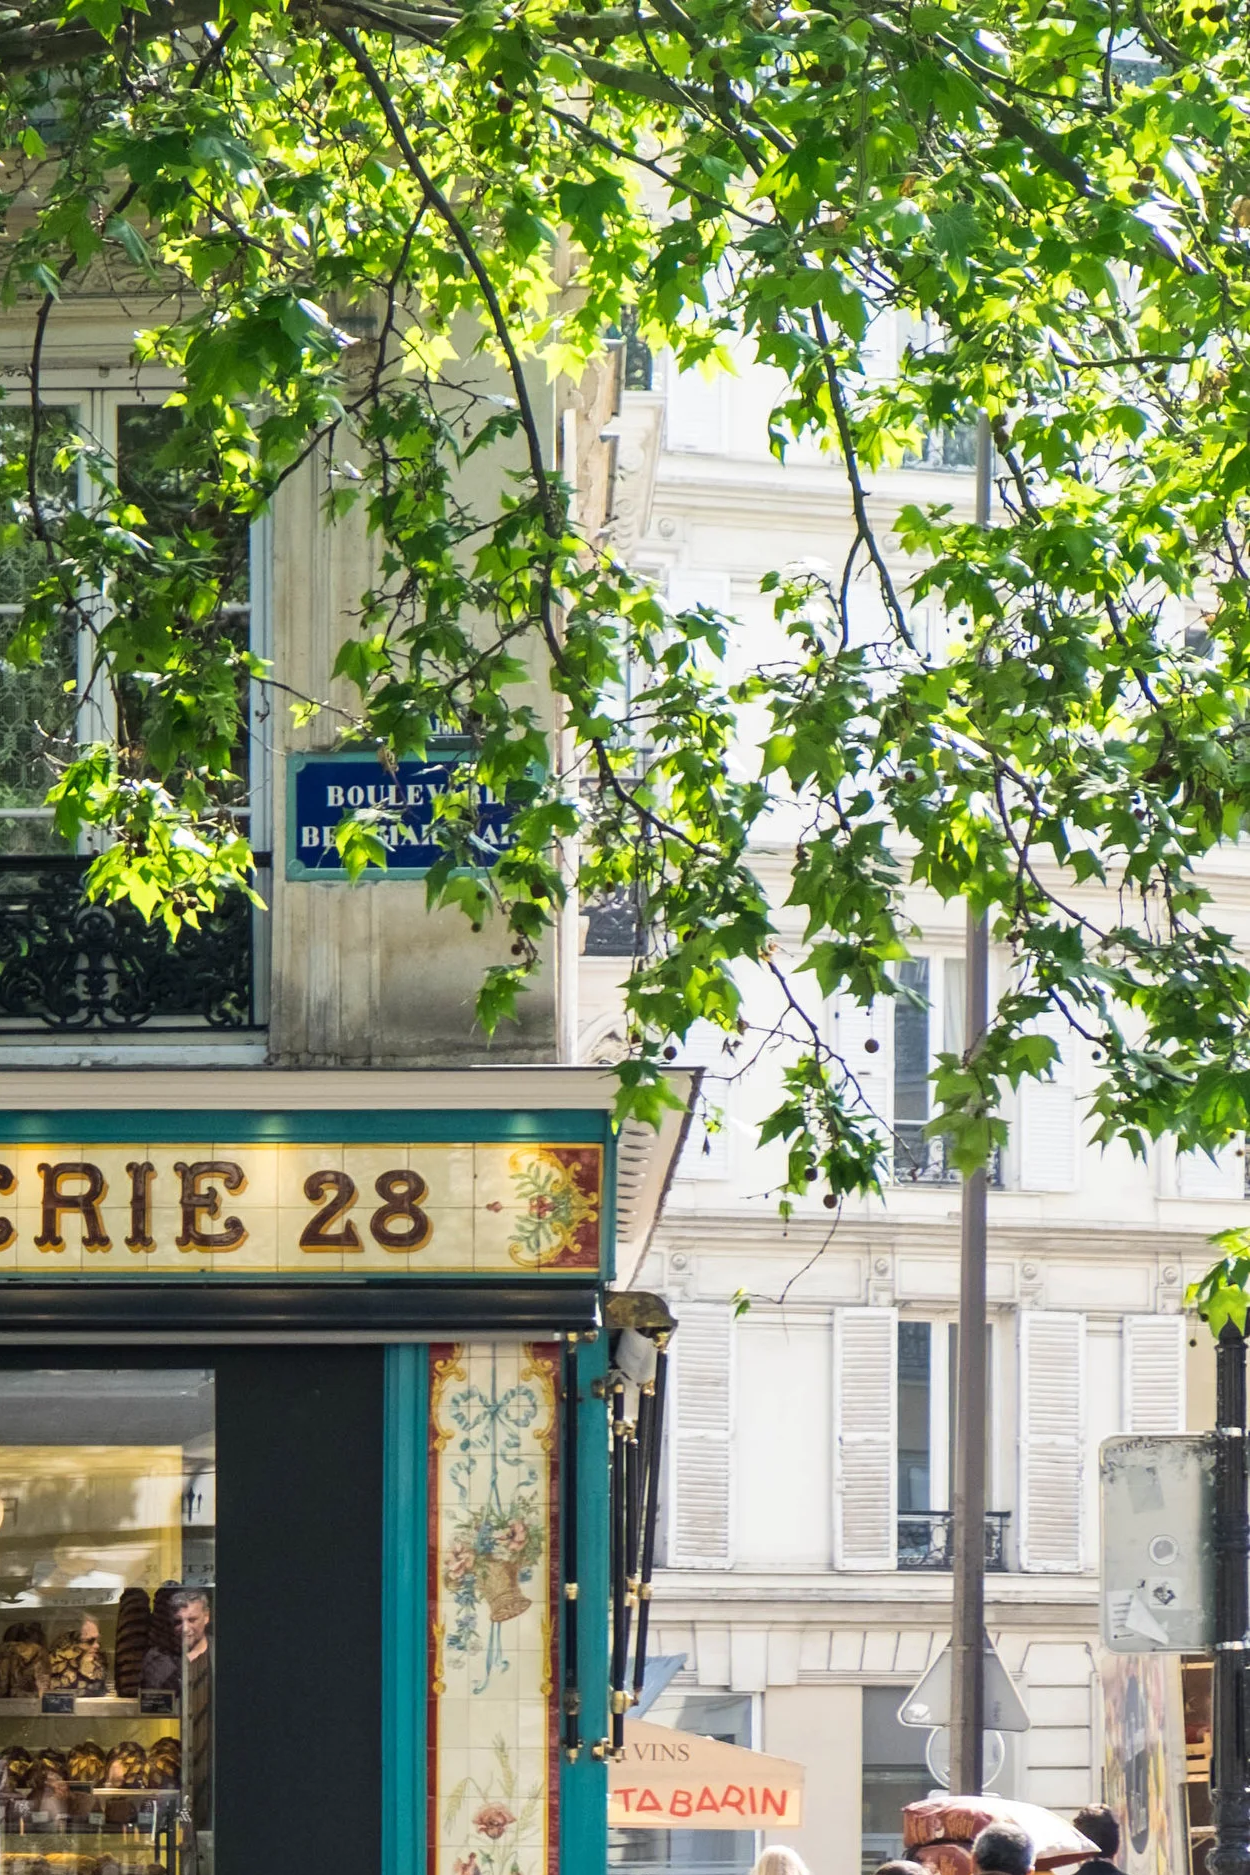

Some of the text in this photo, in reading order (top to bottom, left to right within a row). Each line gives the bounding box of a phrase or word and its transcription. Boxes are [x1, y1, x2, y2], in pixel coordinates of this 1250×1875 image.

[299, 1168, 432, 1254] 28
[633, 1743, 691, 1762] VINS
[613, 1784, 787, 1818] TABARIN
